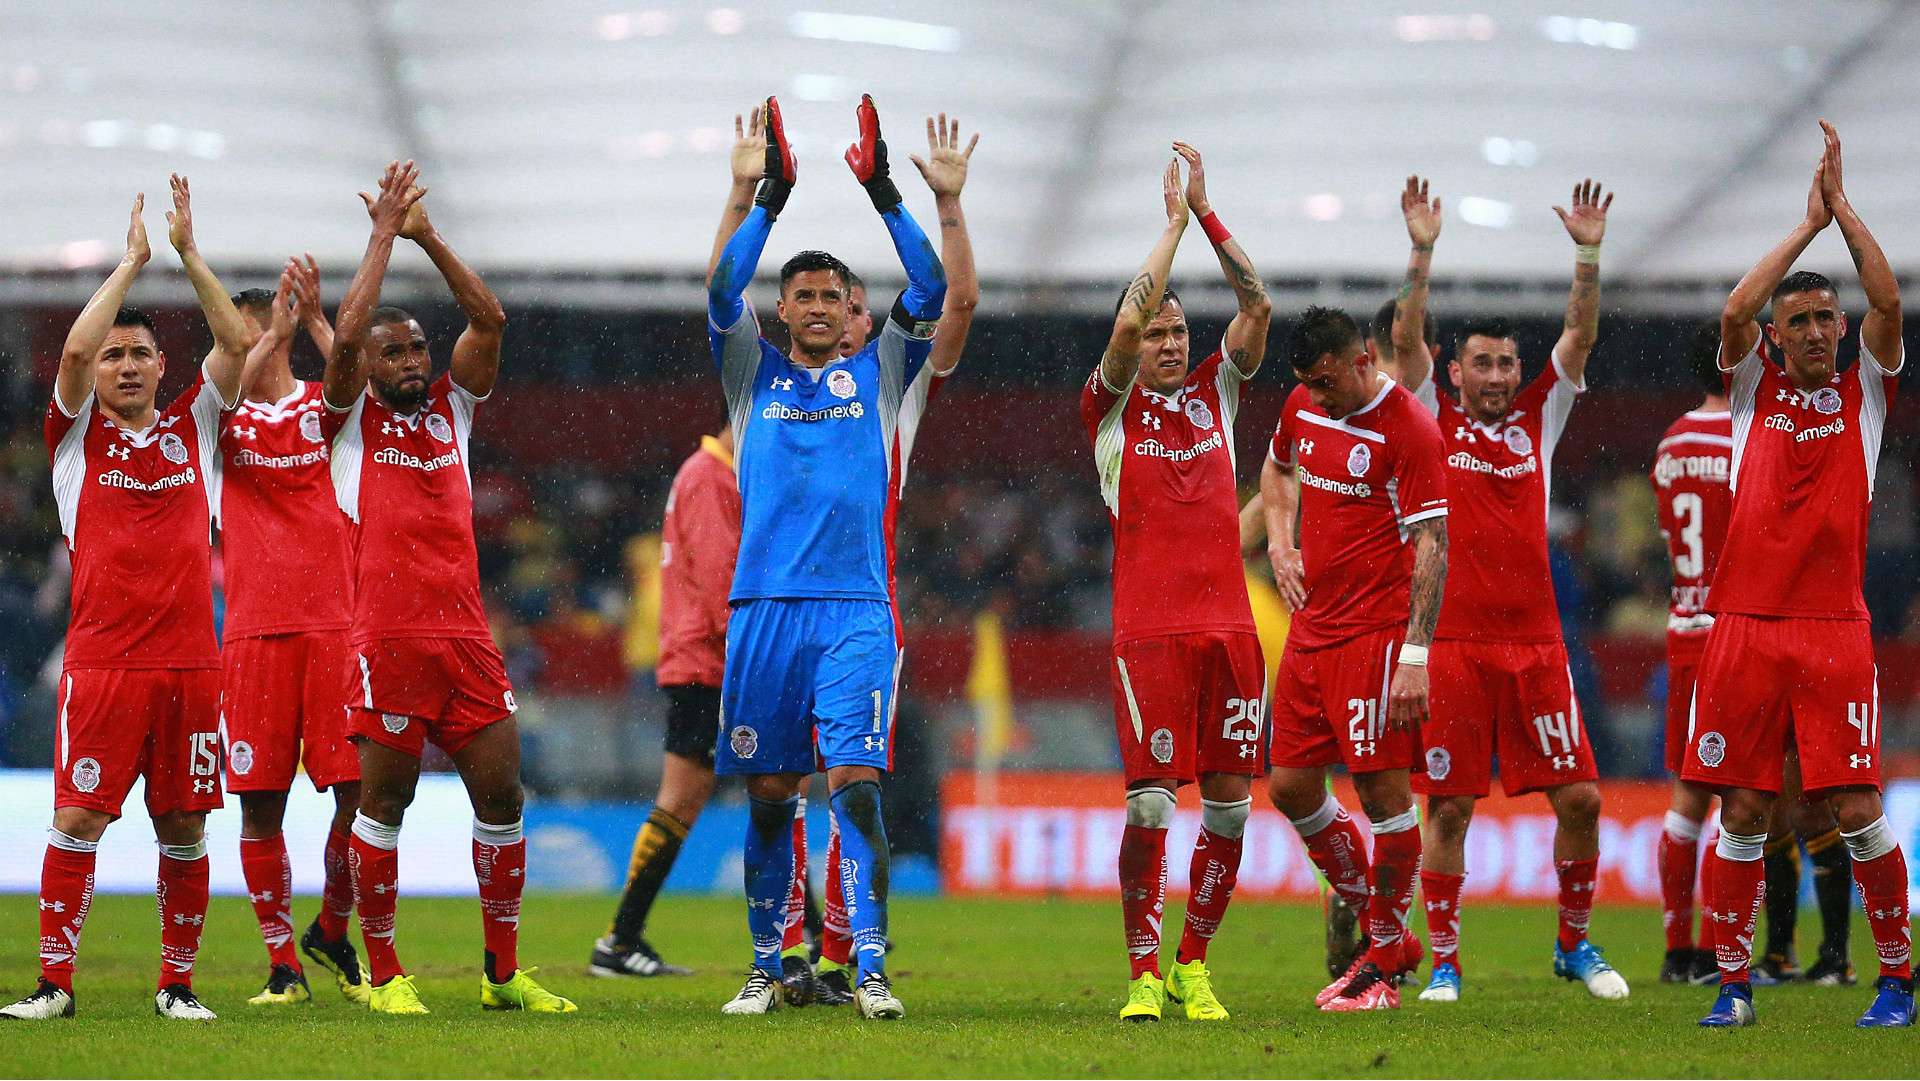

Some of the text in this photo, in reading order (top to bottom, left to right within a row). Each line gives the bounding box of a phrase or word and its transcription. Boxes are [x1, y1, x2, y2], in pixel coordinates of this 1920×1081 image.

[762, 401, 850, 421] citibanamex
[233, 449, 321, 469] citibanamex
[1655, 452, 1729, 486] Corona
[1672, 492, 1704, 578] 3
[871, 690, 881, 733] 1
[1222, 698, 1260, 741] 29
[1348, 698, 1376, 741] 21
[1848, 702, 1868, 747] 4
[190, 732, 217, 776] 15
[1533, 711, 1571, 757] 14
